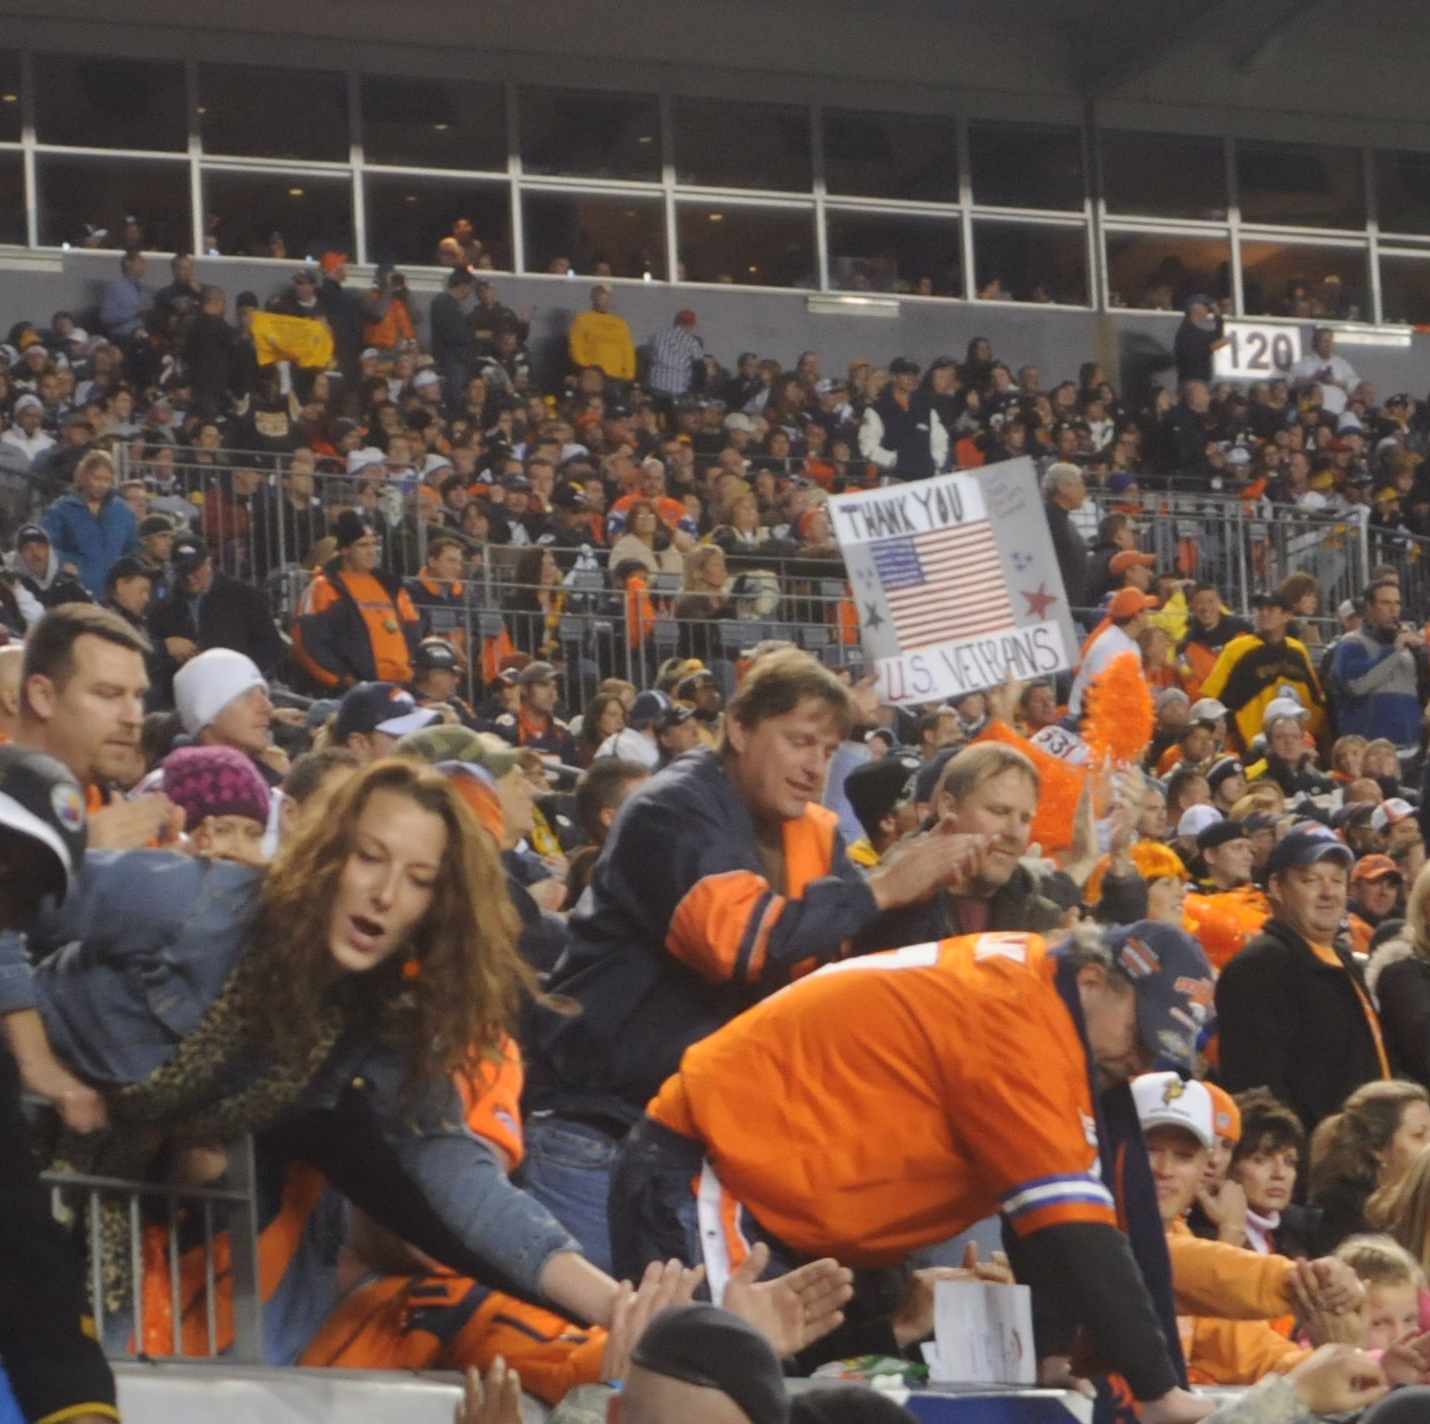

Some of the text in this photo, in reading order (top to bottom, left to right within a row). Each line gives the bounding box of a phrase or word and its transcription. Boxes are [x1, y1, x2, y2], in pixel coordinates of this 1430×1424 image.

[1228, 330, 1293, 373] 120
[840, 492, 917, 539] THANK
[912, 482, 964, 528] YOU
